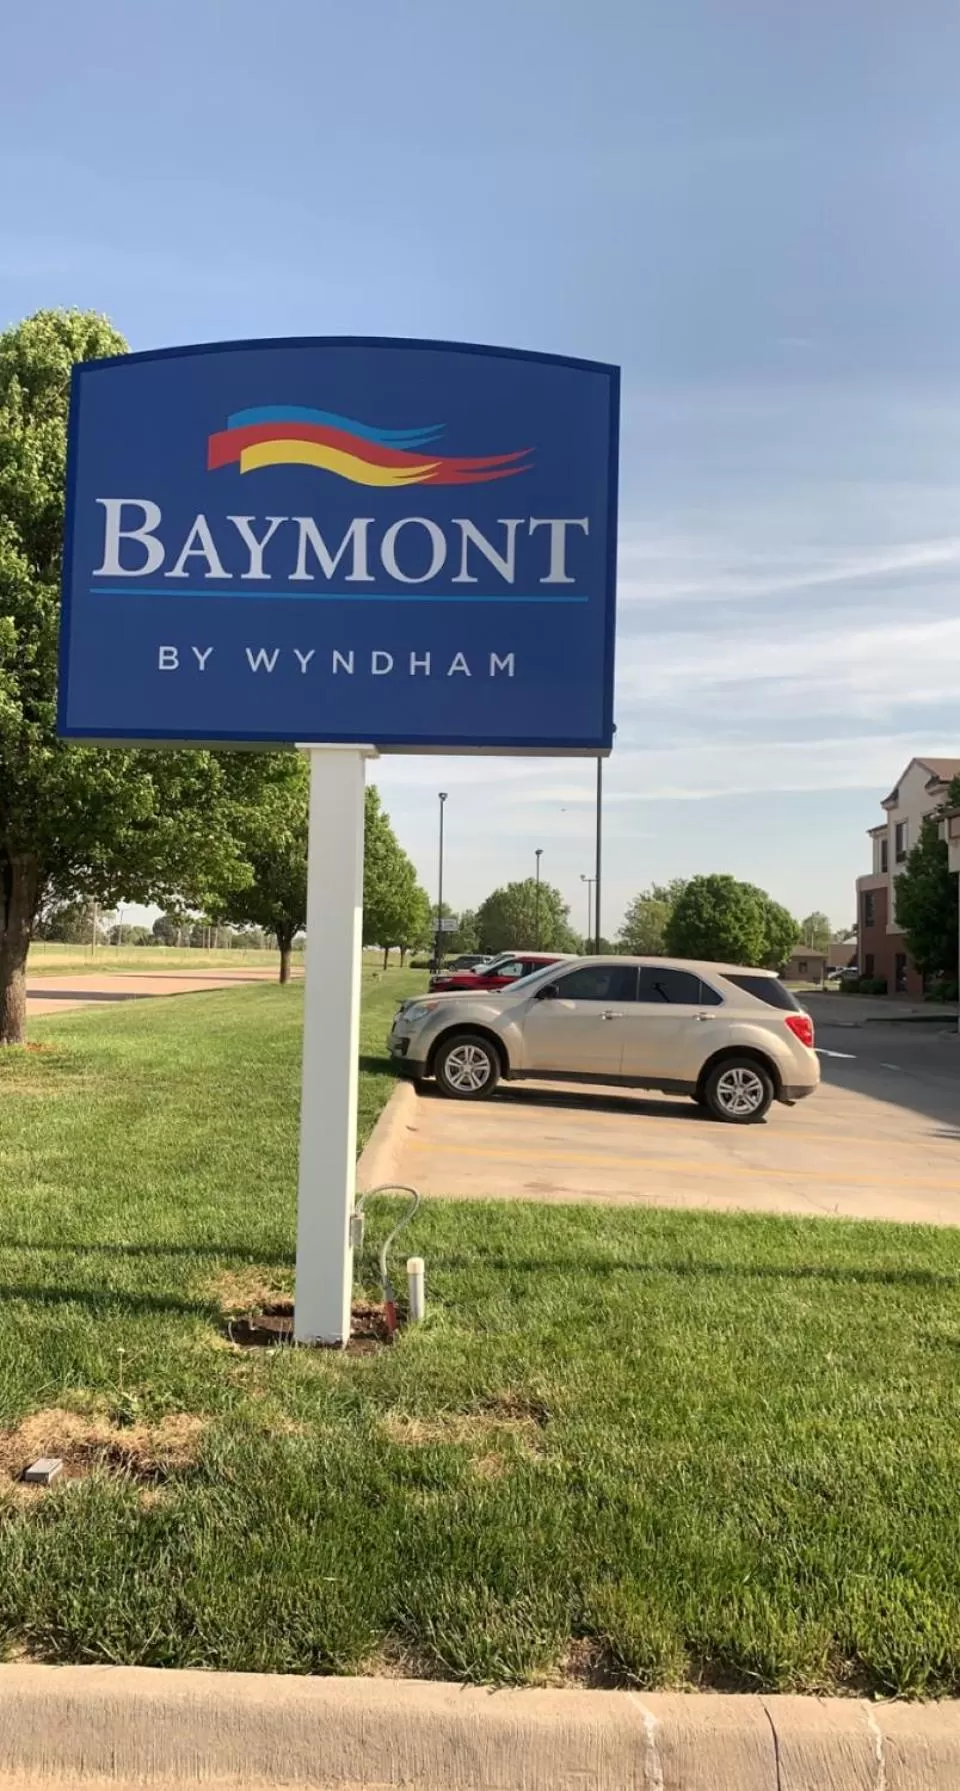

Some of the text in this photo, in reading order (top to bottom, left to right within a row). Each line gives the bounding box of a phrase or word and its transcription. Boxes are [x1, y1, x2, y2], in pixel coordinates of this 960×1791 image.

[92, 498, 589, 584] BAYMONT
[157, 645, 517, 677] BY WYNDHAM
